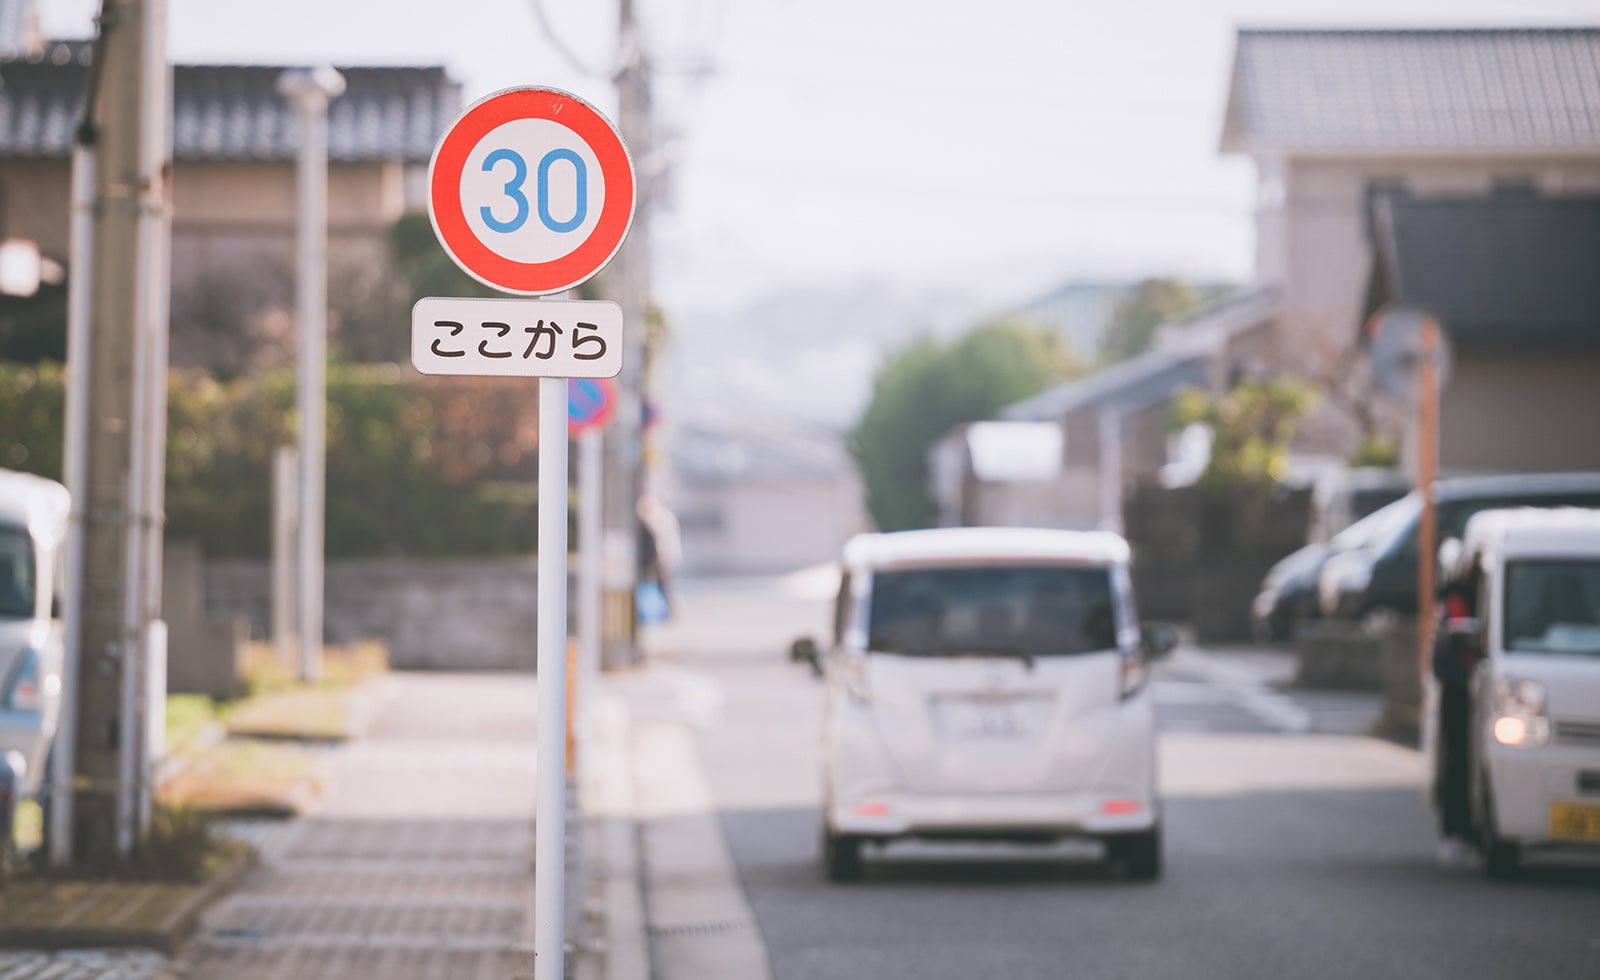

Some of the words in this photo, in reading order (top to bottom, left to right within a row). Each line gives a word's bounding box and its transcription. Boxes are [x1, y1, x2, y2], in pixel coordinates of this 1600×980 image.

[480, 148, 588, 233] 30
[430, 319, 607, 361] ここから
